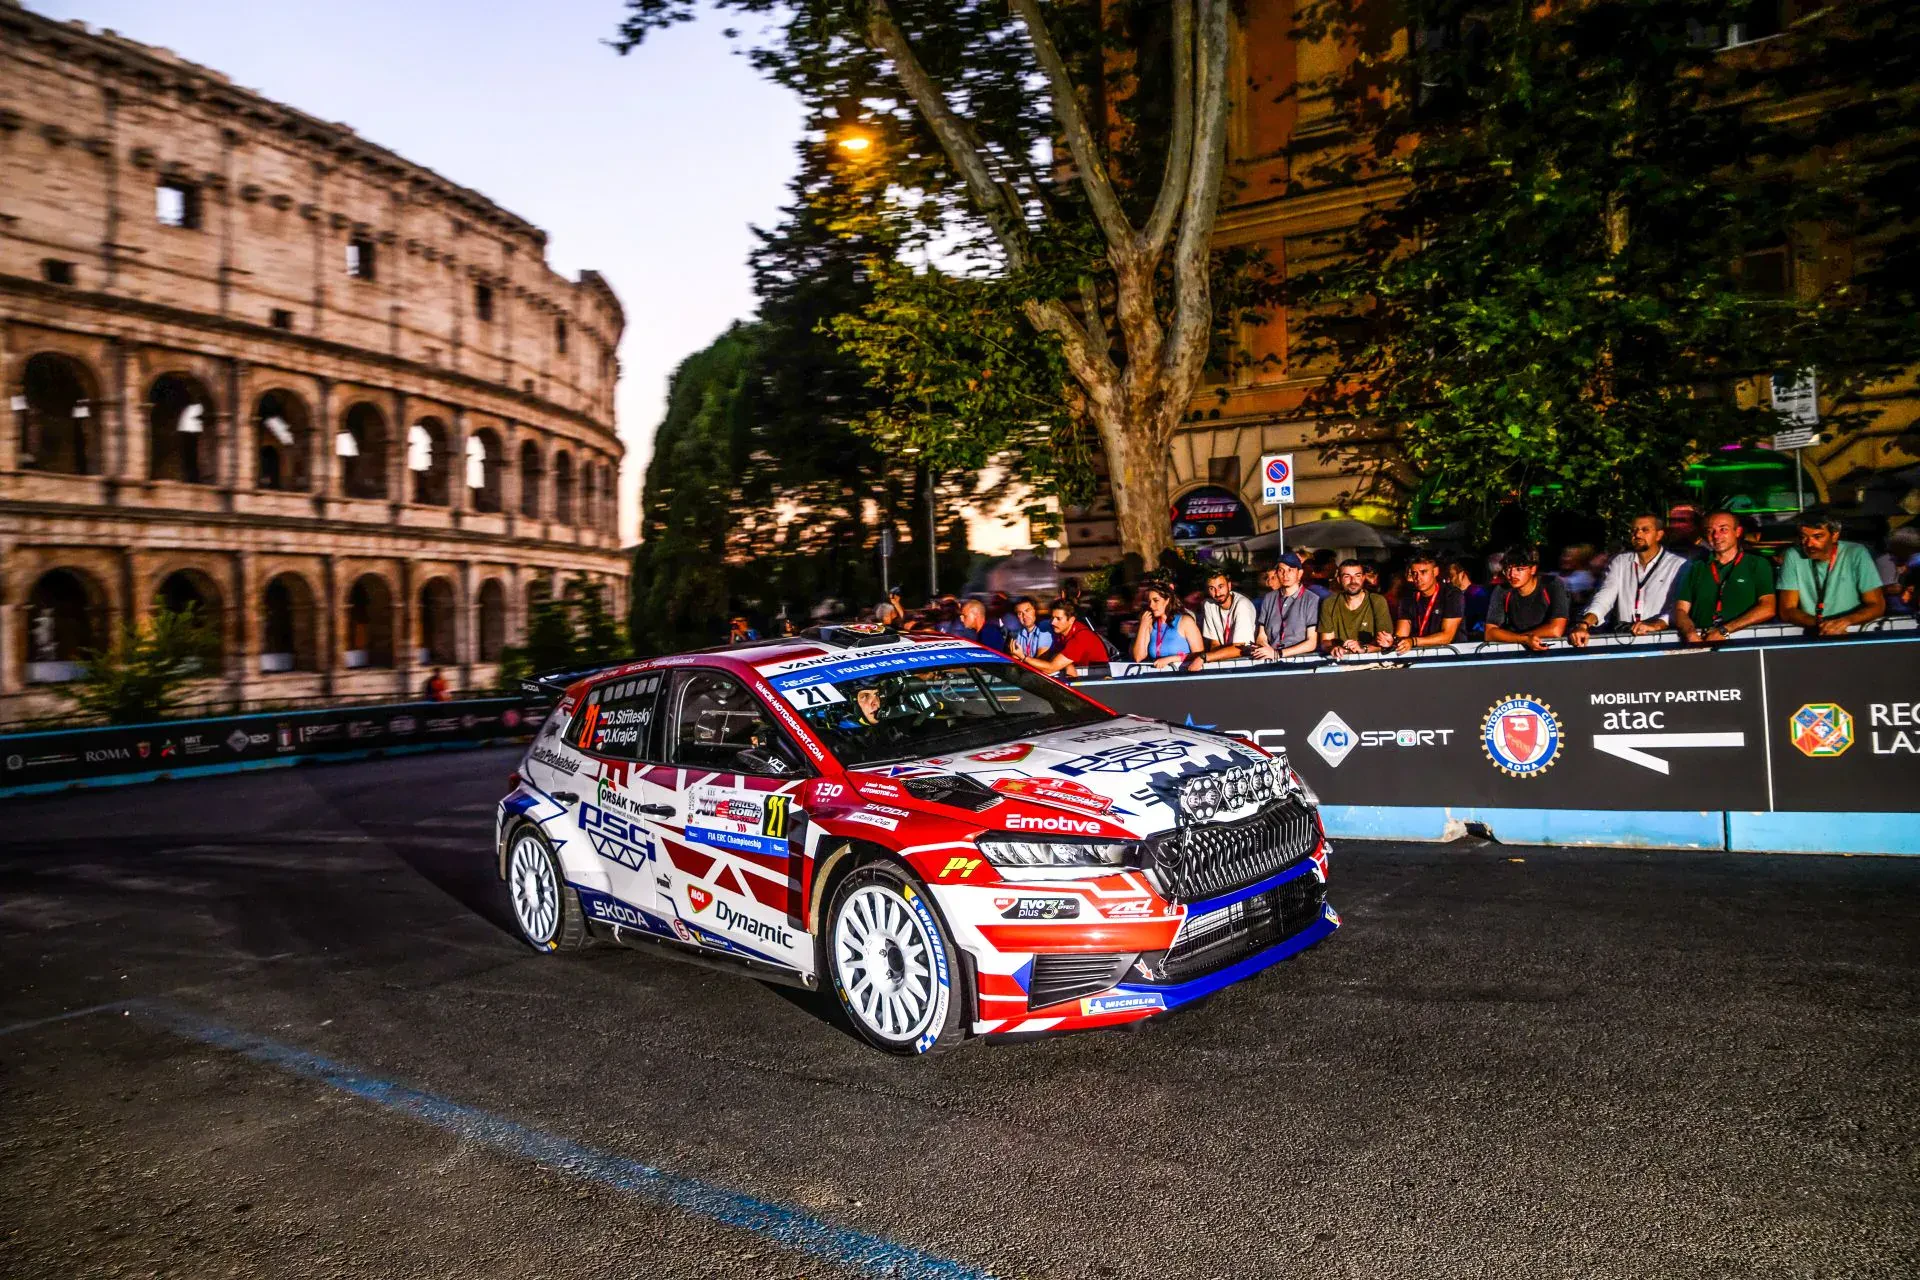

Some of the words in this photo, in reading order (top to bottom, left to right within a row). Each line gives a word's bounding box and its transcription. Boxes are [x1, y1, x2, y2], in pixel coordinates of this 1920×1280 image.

[855, 641, 963, 658] MOTORSPORT
[837, 663, 876, 675] FOLLOW
[796, 686, 830, 706] 21
[1591, 692, 1662, 705] MOBILITY
[1665, 689, 1742, 702] PARTNER
[578, 704, 600, 749] 21
[1486, 701, 1530, 740] AUTOMOBILE
[1541, 712, 1557, 738] CLUB
[1603, 708, 1665, 730] atac
[1323, 732, 1348, 746] ACI
[1361, 729, 1454, 746] SPORT
[86, 748, 130, 762] ROMA
[1506, 762, 1539, 772] ROMA
[601, 789, 628, 809] ORSÁK
[815, 783, 843, 797] 130
[729, 800, 757, 809] RALLY
[729, 808, 762, 819] ROMA
[766, 796, 786, 837] 21
[1005, 814, 1101, 834] Emotive
[708, 832, 716, 840] FIA
[717, 834, 727, 843] ERC
[727, 835, 762, 850] Championship
[938, 857, 983, 878] P1
[1018, 908, 1039, 918] plus
[1020, 899, 1045, 910] EVO
[1041, 900, 1058, 919] 3
[716, 899, 795, 950] Dynamic
[918, 909, 948, 981] MICHELIN
[1105, 998, 1156, 1008] MICHELIN
